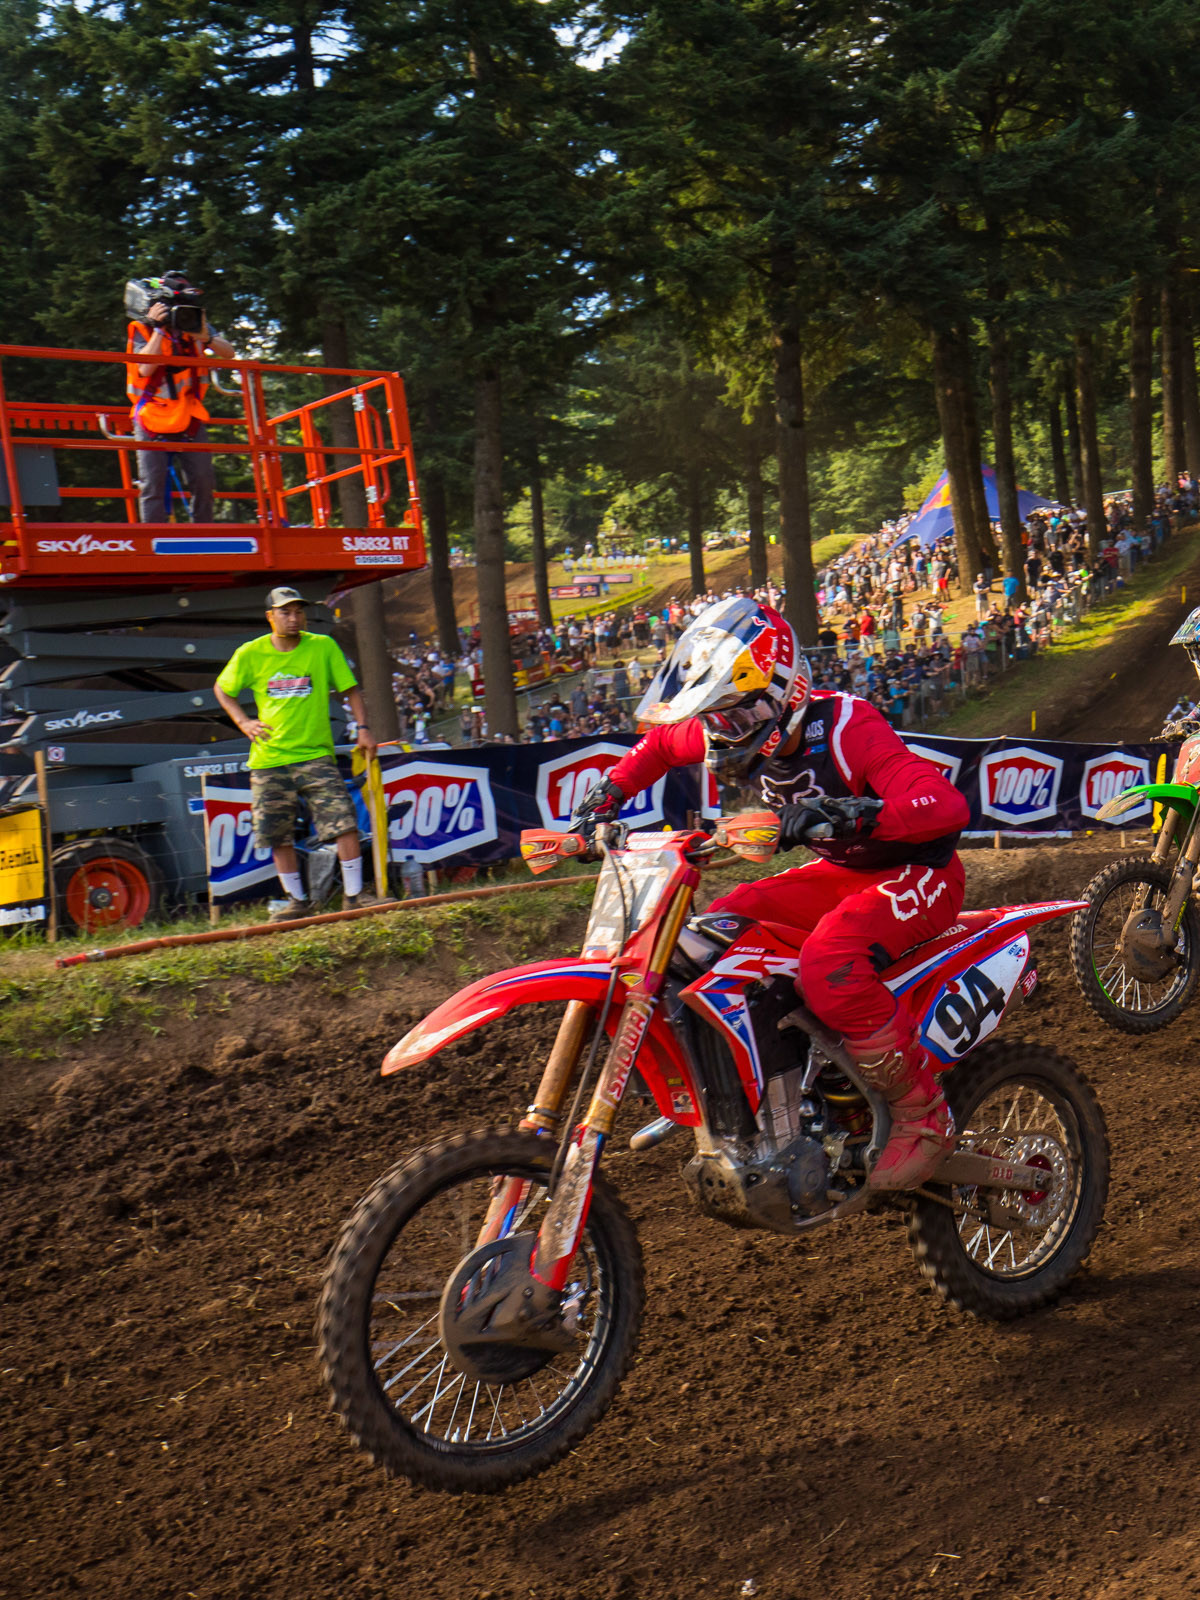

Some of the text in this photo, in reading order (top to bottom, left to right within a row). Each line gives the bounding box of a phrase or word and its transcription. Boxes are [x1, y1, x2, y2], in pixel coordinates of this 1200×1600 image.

[36, 534, 136, 555] SKYJACK
[342, 536, 410, 551] SJ6832 RT
[44, 710, 124, 731] SKYJACK
[994, 766, 1054, 806] 100%
[911, 795, 938, 808] FOX
[935, 963, 1006, 1055] 94
[606, 1009, 650, 1101] SHOWA
